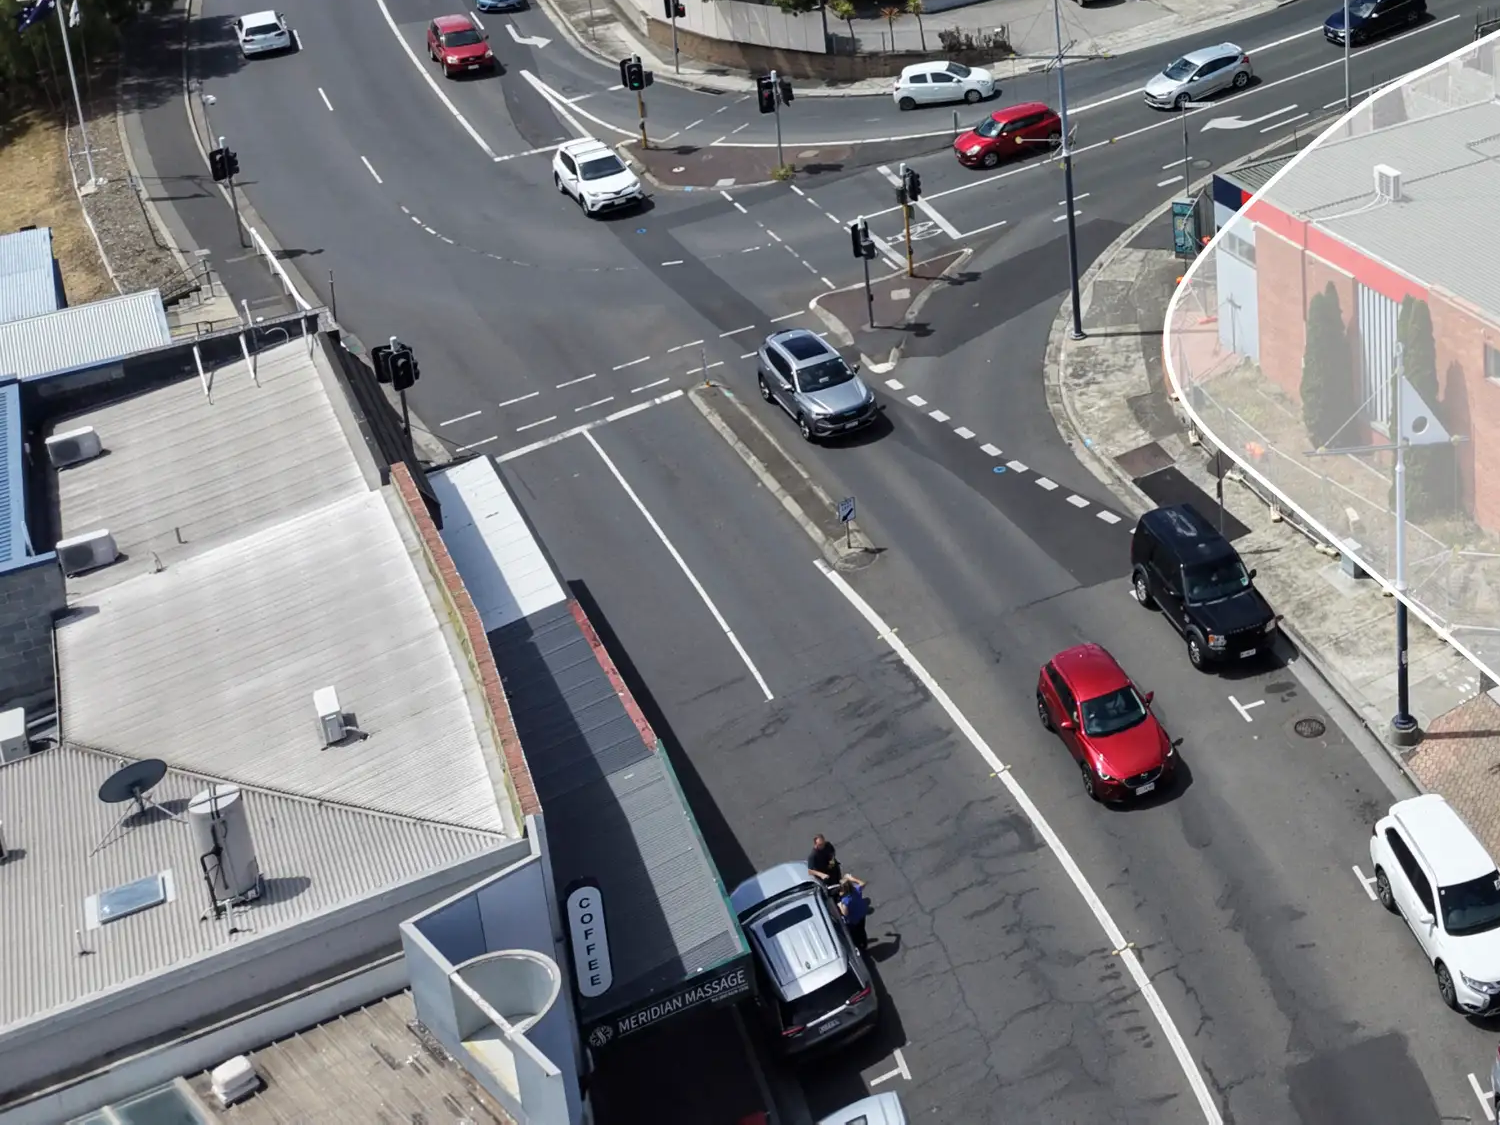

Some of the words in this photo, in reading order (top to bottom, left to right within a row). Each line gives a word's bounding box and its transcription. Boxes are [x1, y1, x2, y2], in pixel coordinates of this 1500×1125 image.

[578, 897, 602, 987] COFFEE
[618, 995, 682, 1033] MERIDIAN
[685, 969, 746, 1005] MASSAGE
